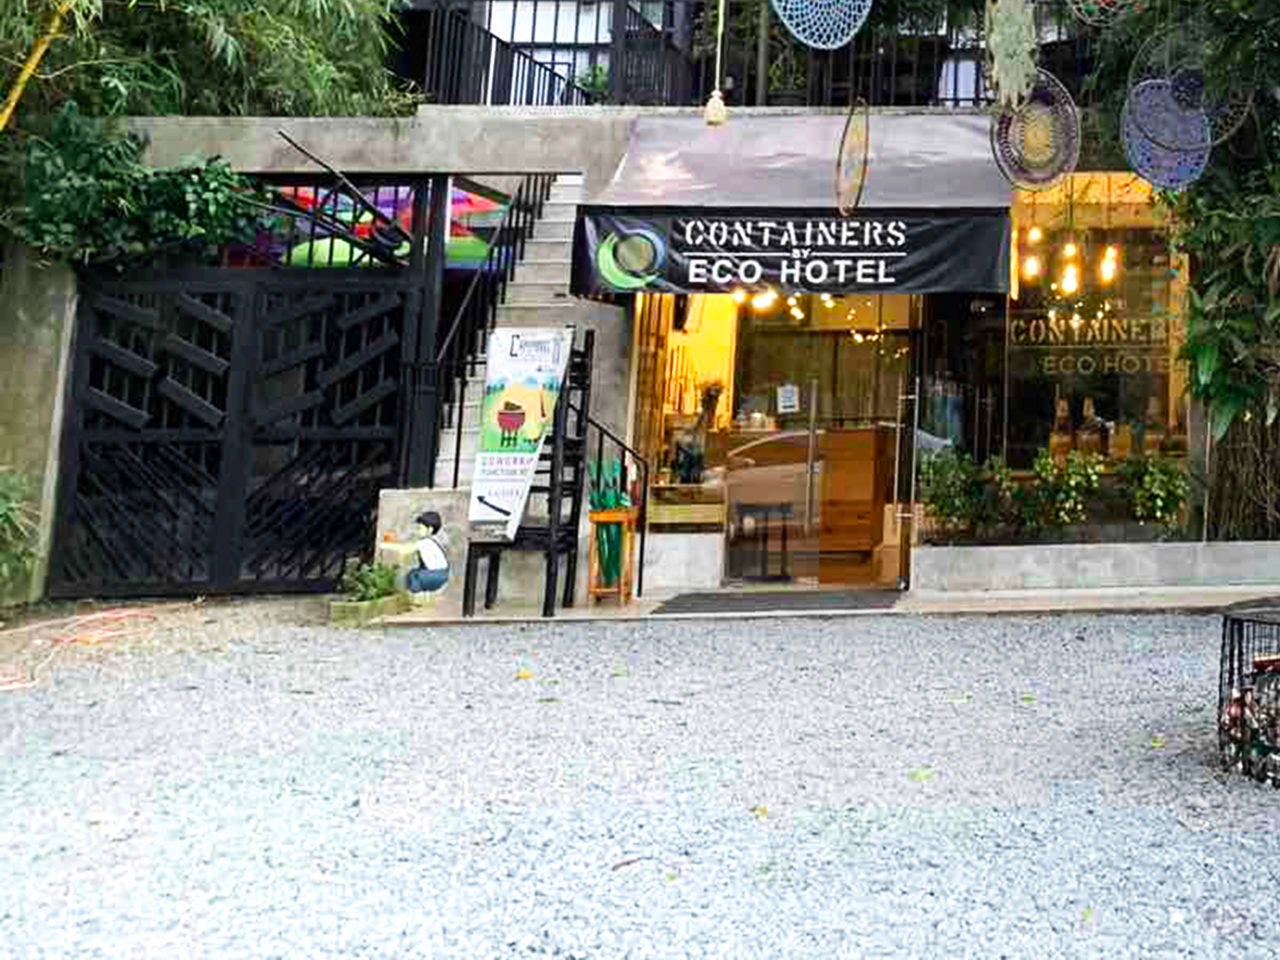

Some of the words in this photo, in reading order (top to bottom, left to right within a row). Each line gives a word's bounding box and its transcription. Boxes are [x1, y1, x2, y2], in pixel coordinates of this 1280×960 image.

[684, 220, 907, 246] CONTAINERS
[791, 248, 811, 258] BY
[688, 259, 762, 284] ECO
[781, 259, 896, 284] HOTEL
[1043, 355, 1097, 375] ECO
